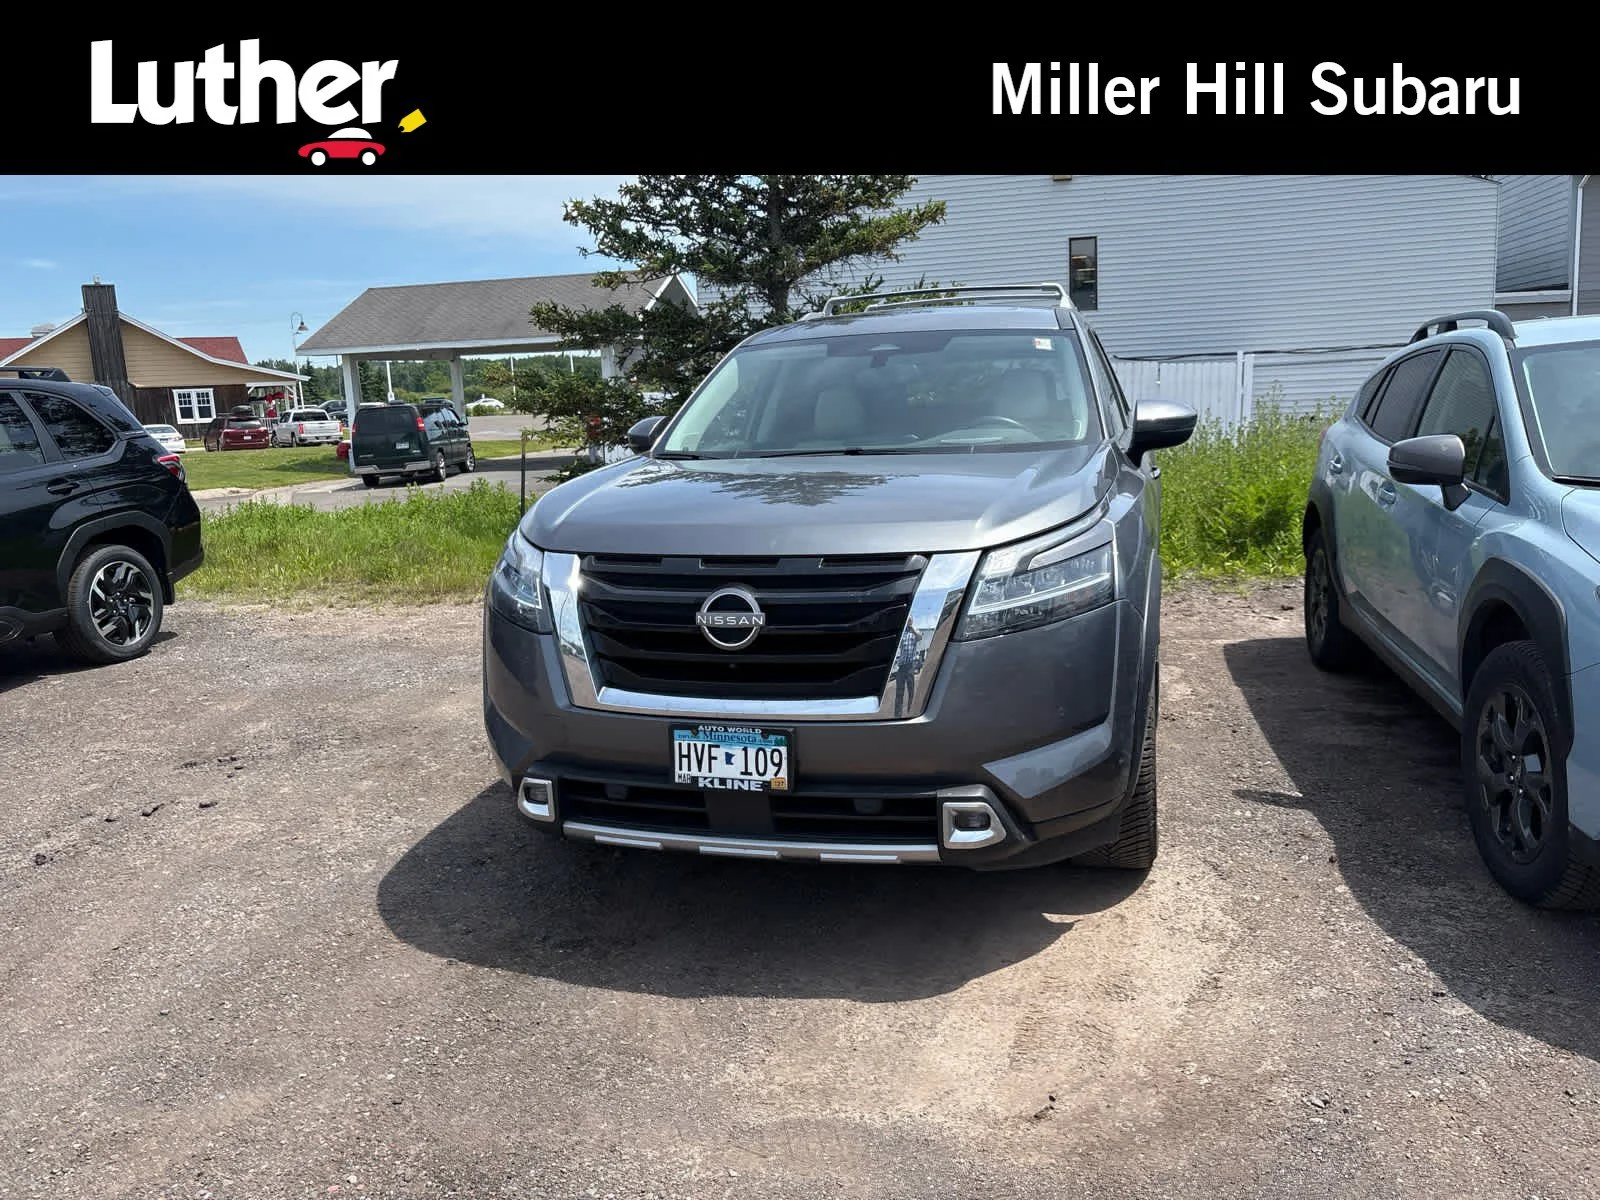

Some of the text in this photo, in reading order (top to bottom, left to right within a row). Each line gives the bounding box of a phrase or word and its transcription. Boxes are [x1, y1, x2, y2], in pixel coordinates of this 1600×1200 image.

[697, 615, 764, 625] NISSAN
[727, 726, 763, 734] WORLD
[703, 731, 757, 744] Minnesota
[677, 742, 783, 778] HVF 109
[698, 776, 764, 792] KLINE
